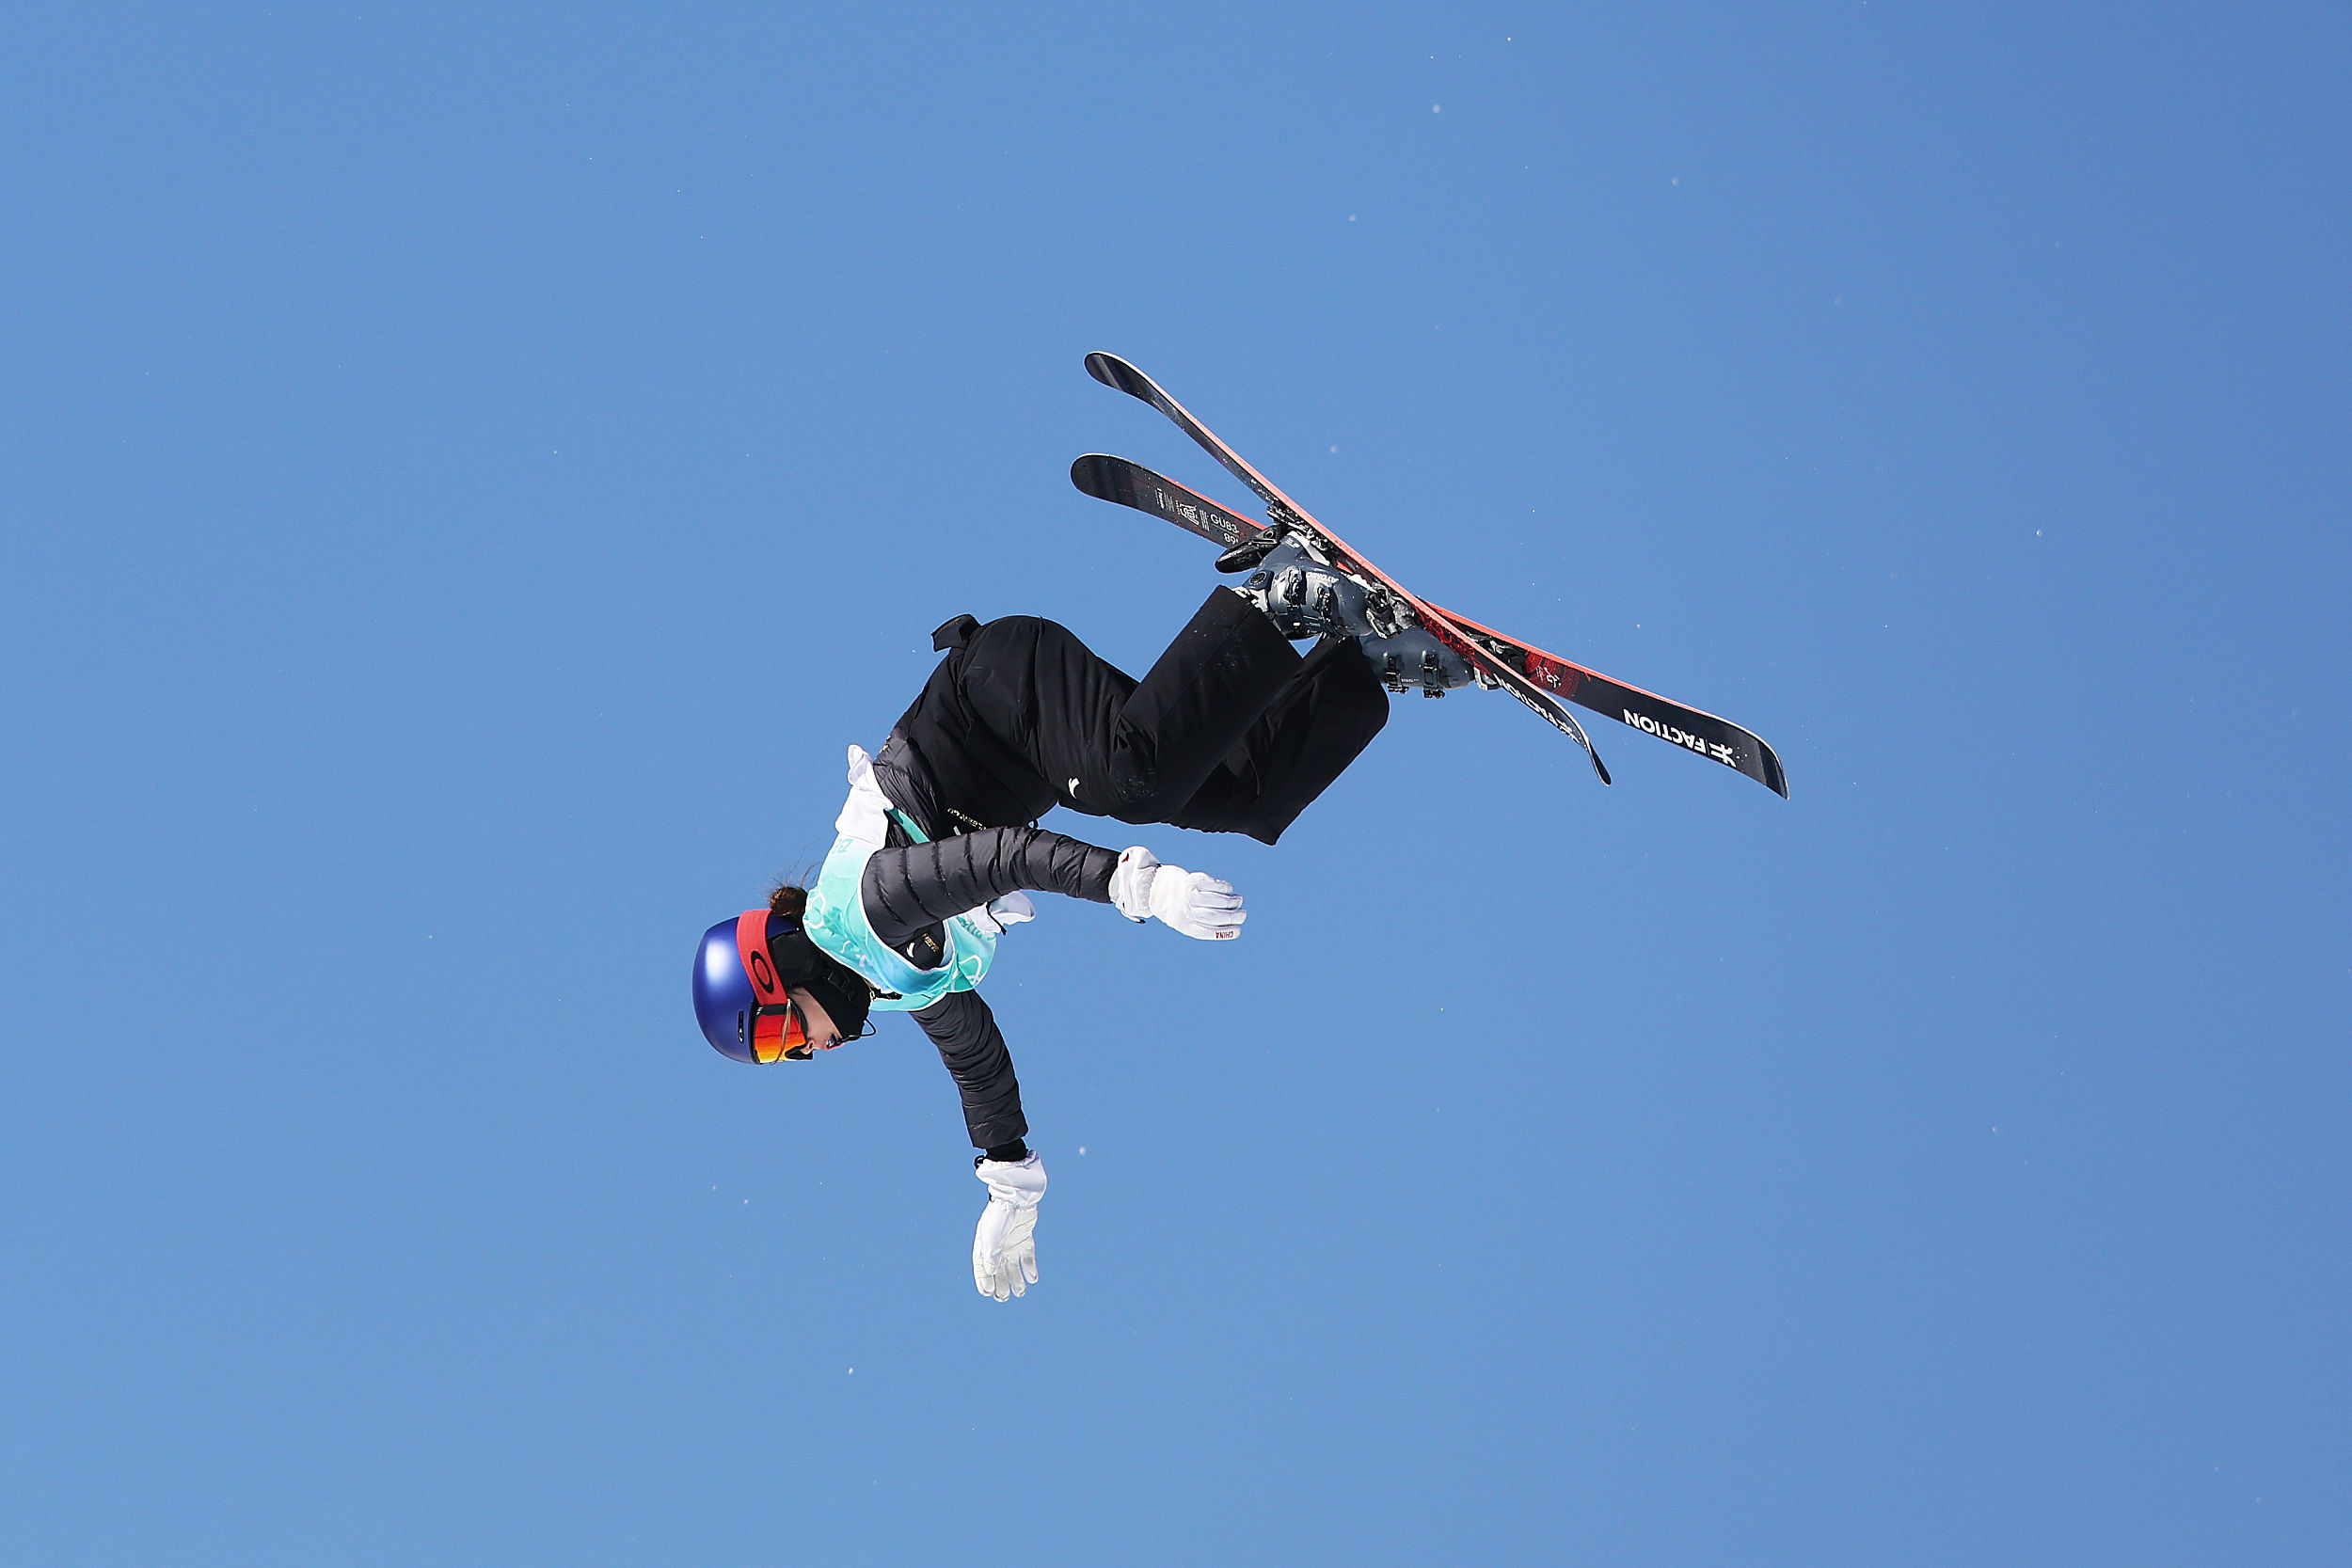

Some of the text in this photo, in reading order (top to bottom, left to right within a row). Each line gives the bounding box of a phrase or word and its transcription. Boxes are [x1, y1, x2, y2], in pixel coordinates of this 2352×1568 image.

[1493, 673, 1558, 726] FACTION
[1623, 708, 1706, 756] FACTION
[1216, 930, 1233, 939] CHINA
